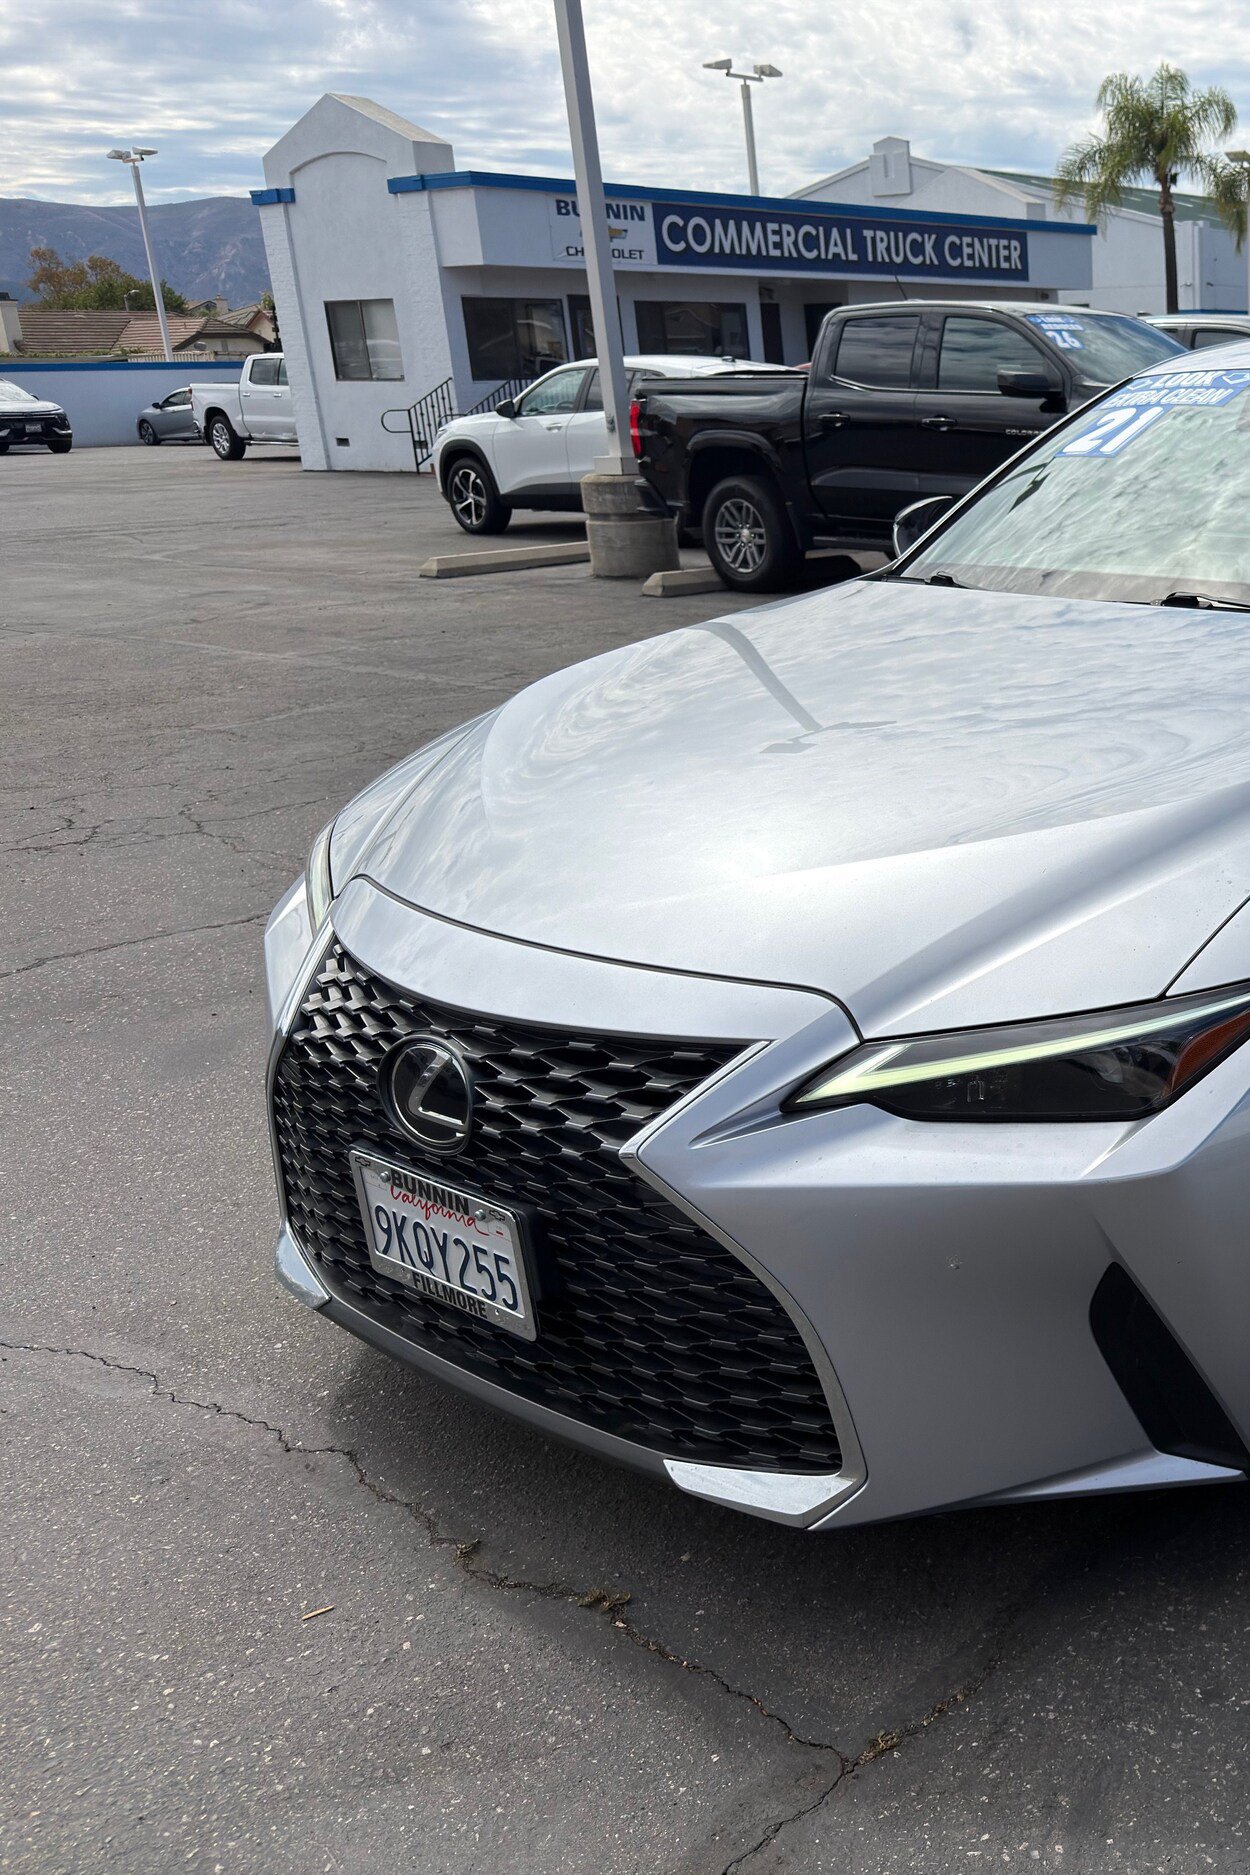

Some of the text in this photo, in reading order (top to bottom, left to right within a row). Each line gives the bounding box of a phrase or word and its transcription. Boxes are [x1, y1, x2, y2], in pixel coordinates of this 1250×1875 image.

[555, 199, 646, 221] BUNIN
[565, 245, 645, 260] CHOLET
[662, 214, 1022, 270] COMMERCIAL TRUCK CENTER
[1045, 331, 1081, 348] 26
[1151, 371, 1227, 389] LOOK
[1102, 388, 1235, 409] EXTRA CLEAN
[1062, 406, 1165, 455] 21
[390, 1168, 470, 1217] BUNNIN
[374, 1205, 519, 1312] 9KQY255
[412, 1272, 488, 1319] FILLMORE
